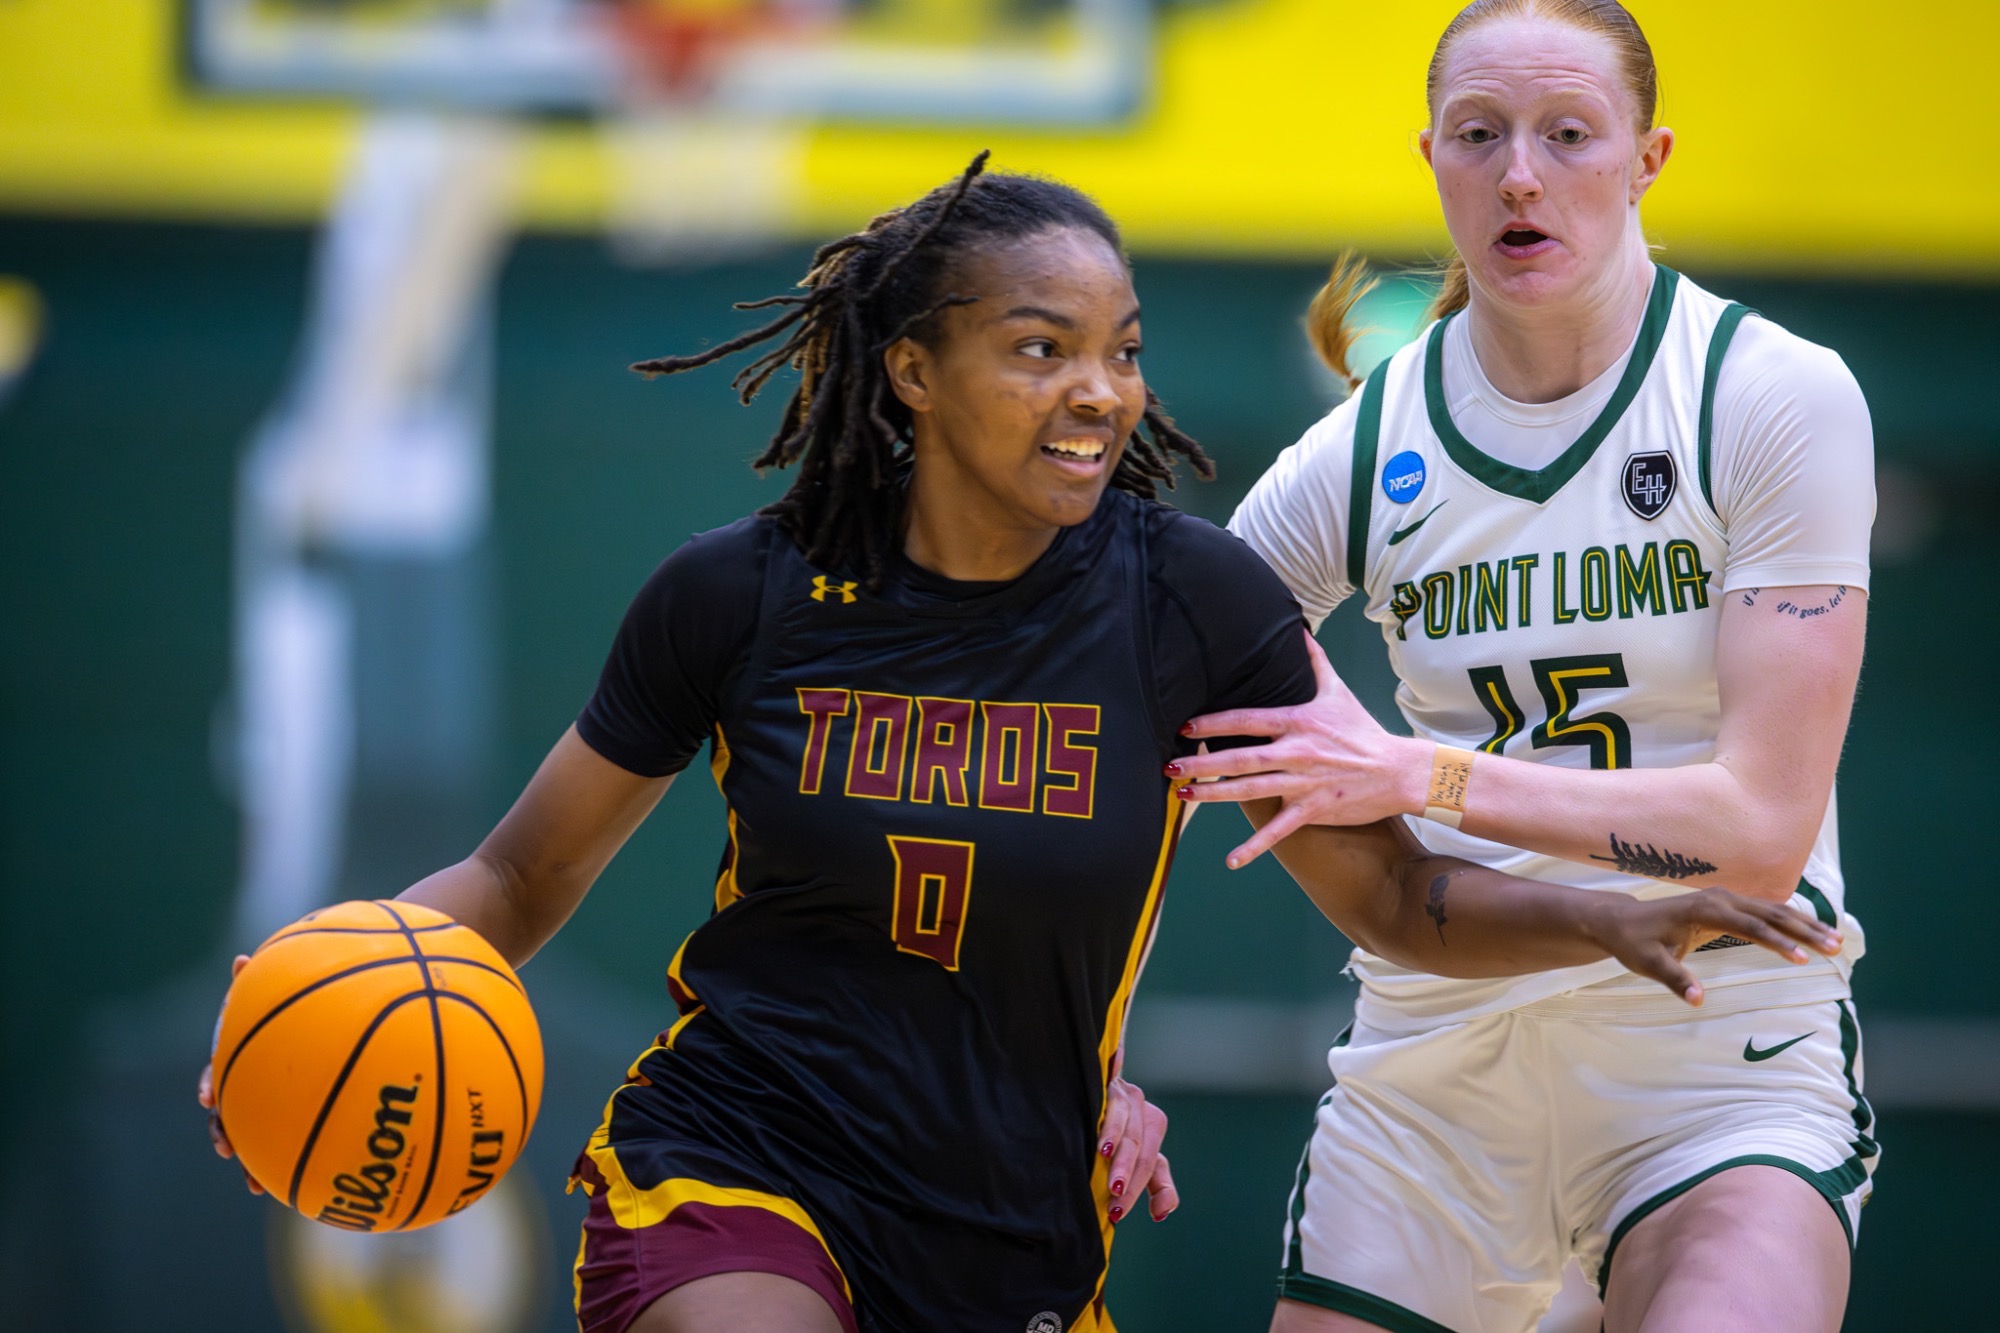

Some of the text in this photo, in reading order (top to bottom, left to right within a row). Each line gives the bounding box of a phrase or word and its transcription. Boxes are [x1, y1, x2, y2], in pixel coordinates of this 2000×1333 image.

[1389, 470, 1423, 493] NCAA
[1631, 462, 1667, 505] EH
[1389, 538, 1712, 641] POINT LOMA
[1799, 605, 1829, 619] goes,
[795, 687, 1101, 819] TOROS
[1467, 653, 1632, 770] 15
[886, 834, 975, 972] 0
[316, 1083, 420, 1232] Wilson
[467, 1086, 485, 1128] NXT
